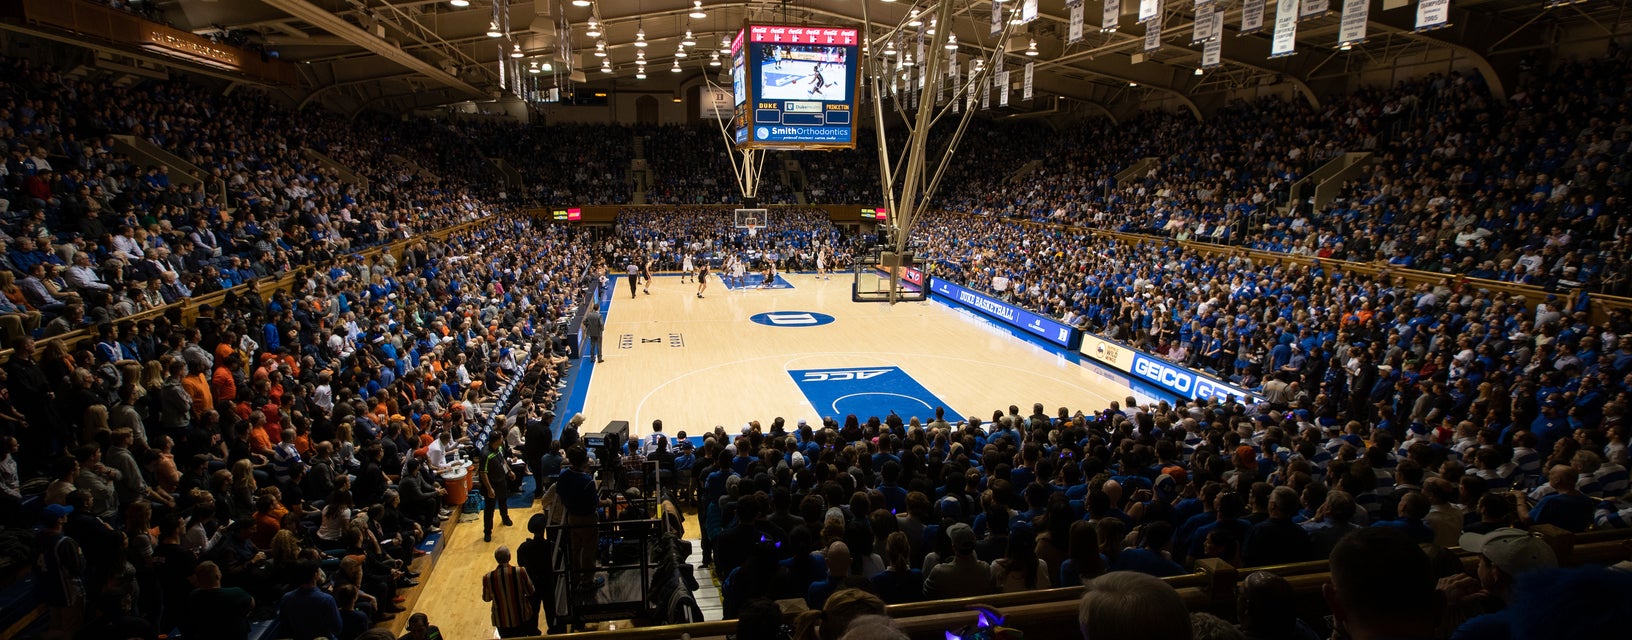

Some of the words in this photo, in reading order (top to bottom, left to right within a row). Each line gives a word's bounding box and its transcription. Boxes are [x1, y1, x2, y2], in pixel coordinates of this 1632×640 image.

[772, 127, 848, 135] SmithOrthodontics
[959, 290, 976, 305] DUKE
[974, 295, 1014, 321] BASKETBALL
[621, 334, 634, 349] COACH
[669, 333, 681, 348] COURT
[801, 369, 896, 382] ACC
[1135, 357, 1192, 393] GEICO
